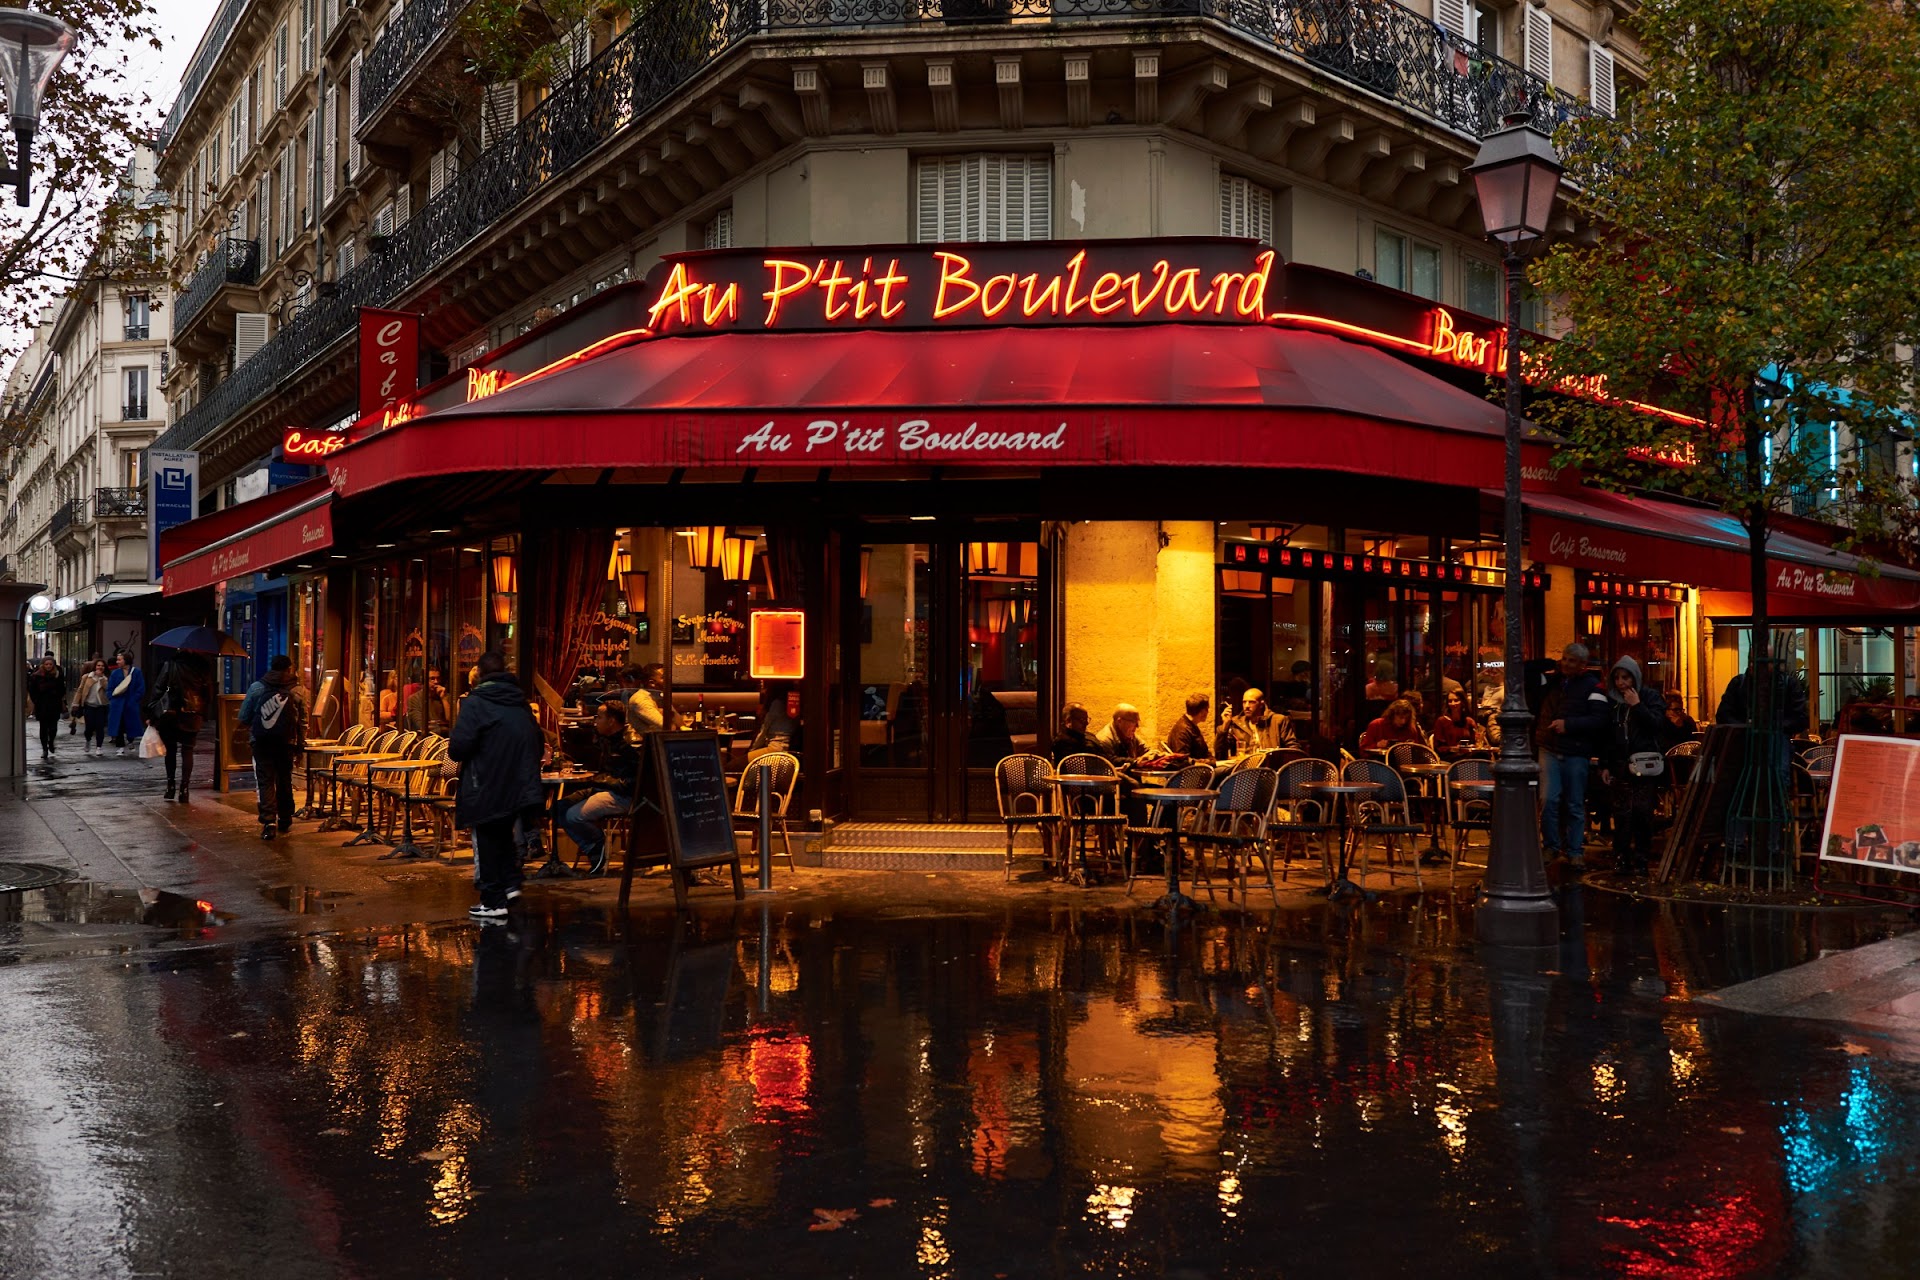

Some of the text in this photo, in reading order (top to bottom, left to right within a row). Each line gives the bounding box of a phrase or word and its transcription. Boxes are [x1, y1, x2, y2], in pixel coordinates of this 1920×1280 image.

[648, 248, 1275, 329] Au P'tit Boulevard
[1432, 307, 1491, 365] Bar
[466, 367, 499, 402] Bar
[736, 419, 1067, 453] Au P'tit Boulevard
[1520, 466, 1560, 481] asserie
[1549, 532, 1576, 560] Café
[1776, 567, 1791, 588] Au
[260, 693, 283, 720] NIKE
